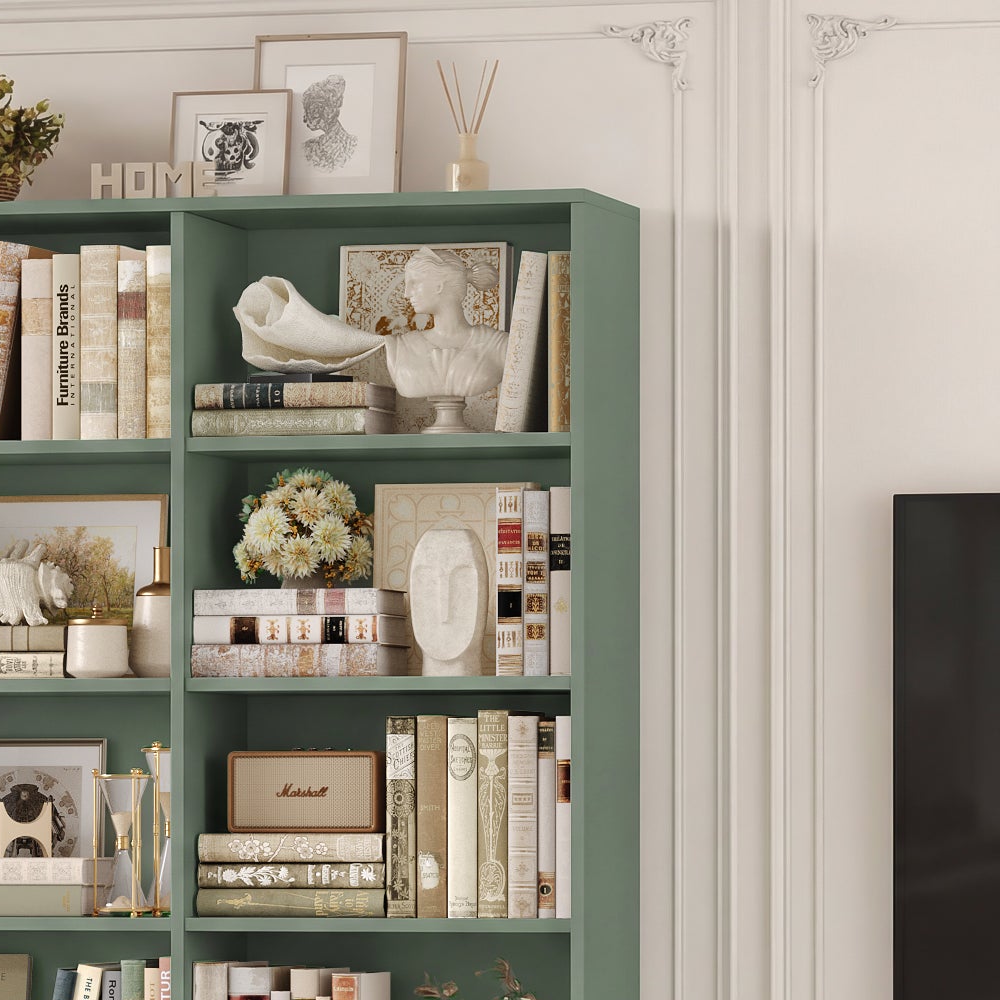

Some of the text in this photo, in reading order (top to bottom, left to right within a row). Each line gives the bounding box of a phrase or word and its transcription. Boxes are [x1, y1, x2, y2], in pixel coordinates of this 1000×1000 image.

[91, 162, 217, 199] HOME
[56, 284, 69, 406] Furniture Brands
[484, 714, 500, 722] THE
[479, 724, 506, 732] LITTLE
[478, 733, 508, 741] MINISTER
[276, 783, 329, 798] Marshall
[420, 804, 441, 812] SMITH
[314, 891, 329, 916] Land
[85, 977, 93, 992] THE
